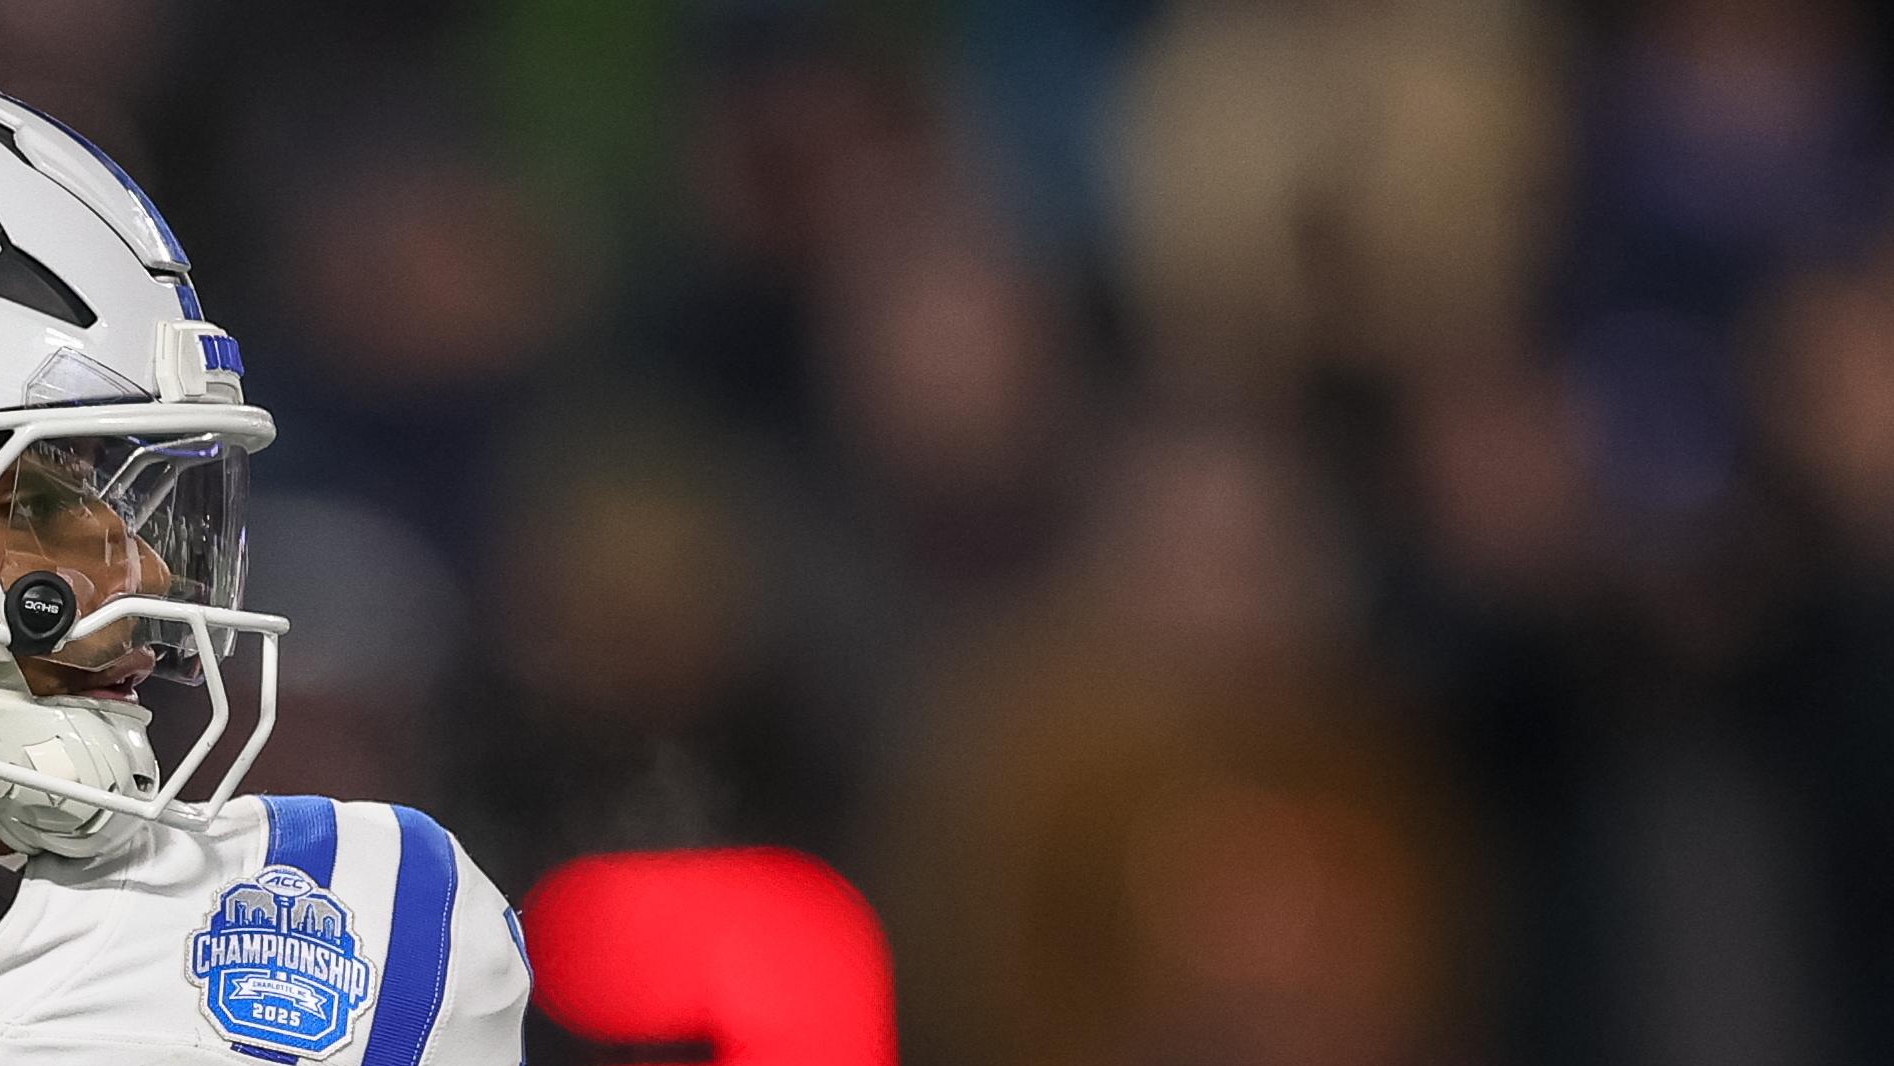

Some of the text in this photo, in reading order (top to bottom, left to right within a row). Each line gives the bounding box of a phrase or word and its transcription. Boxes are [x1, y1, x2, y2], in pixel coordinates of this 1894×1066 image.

[265, 875, 306, 890] ACC
[196, 933, 367, 1005] CHAMPIONSHIP
[252, 1002, 301, 1027] 2025
